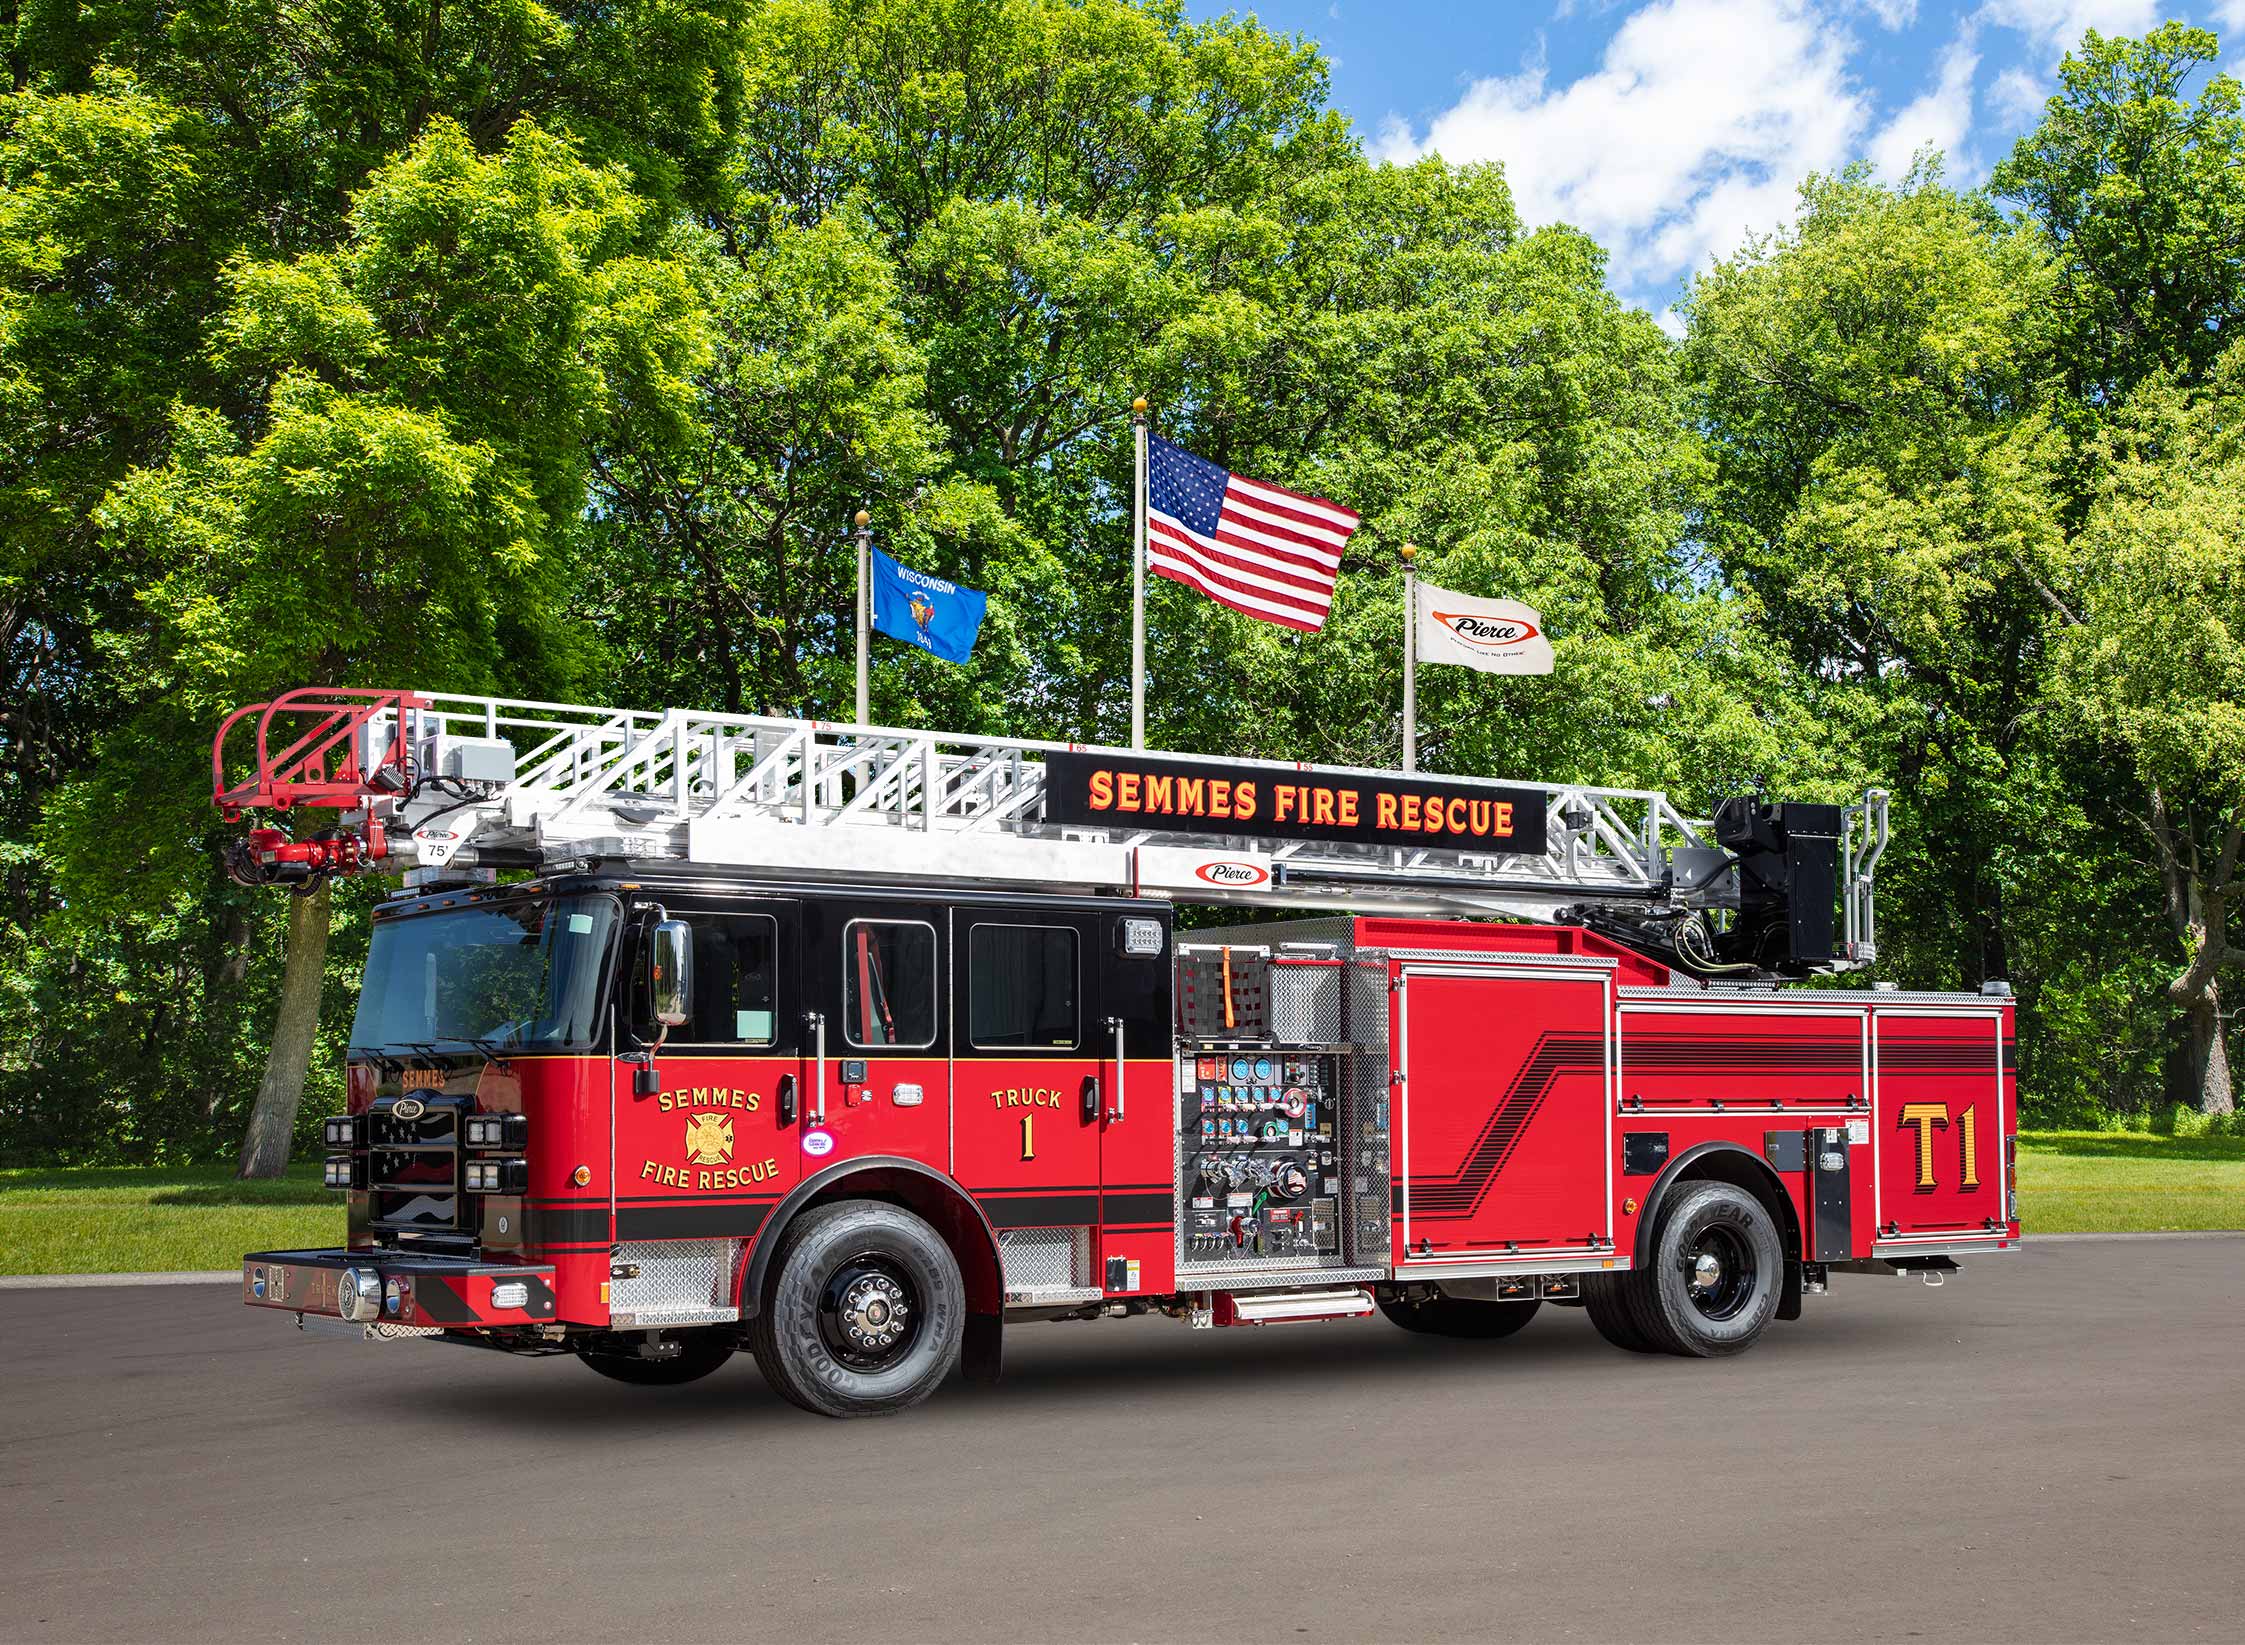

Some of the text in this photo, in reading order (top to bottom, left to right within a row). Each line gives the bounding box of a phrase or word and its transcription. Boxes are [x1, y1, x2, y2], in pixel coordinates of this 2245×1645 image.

[897, 566, 956, 595] WISCONSIN
[1455, 618, 1517, 638] Pierce
[820, 721, 832, 731] 75
[1076, 744, 1086, 752] 65
[1303, 763, 1312, 772] 55
[1088, 770, 1514, 837] SEMMES FIRE RESCUE
[1211, 864, 1253, 880] Pierce
[402, 1069, 446, 1088] SEMMES
[658, 1087, 761, 1112] SEMMES
[989, 1087, 1062, 1110] TRUCK
[1019, 1112, 1036, 1161] 1
[698, 1154, 721, 1164] RESCUE
[1896, 1102, 1981, 1195] T1
[640, 1158, 780, 1190] FIRE RESCUE
